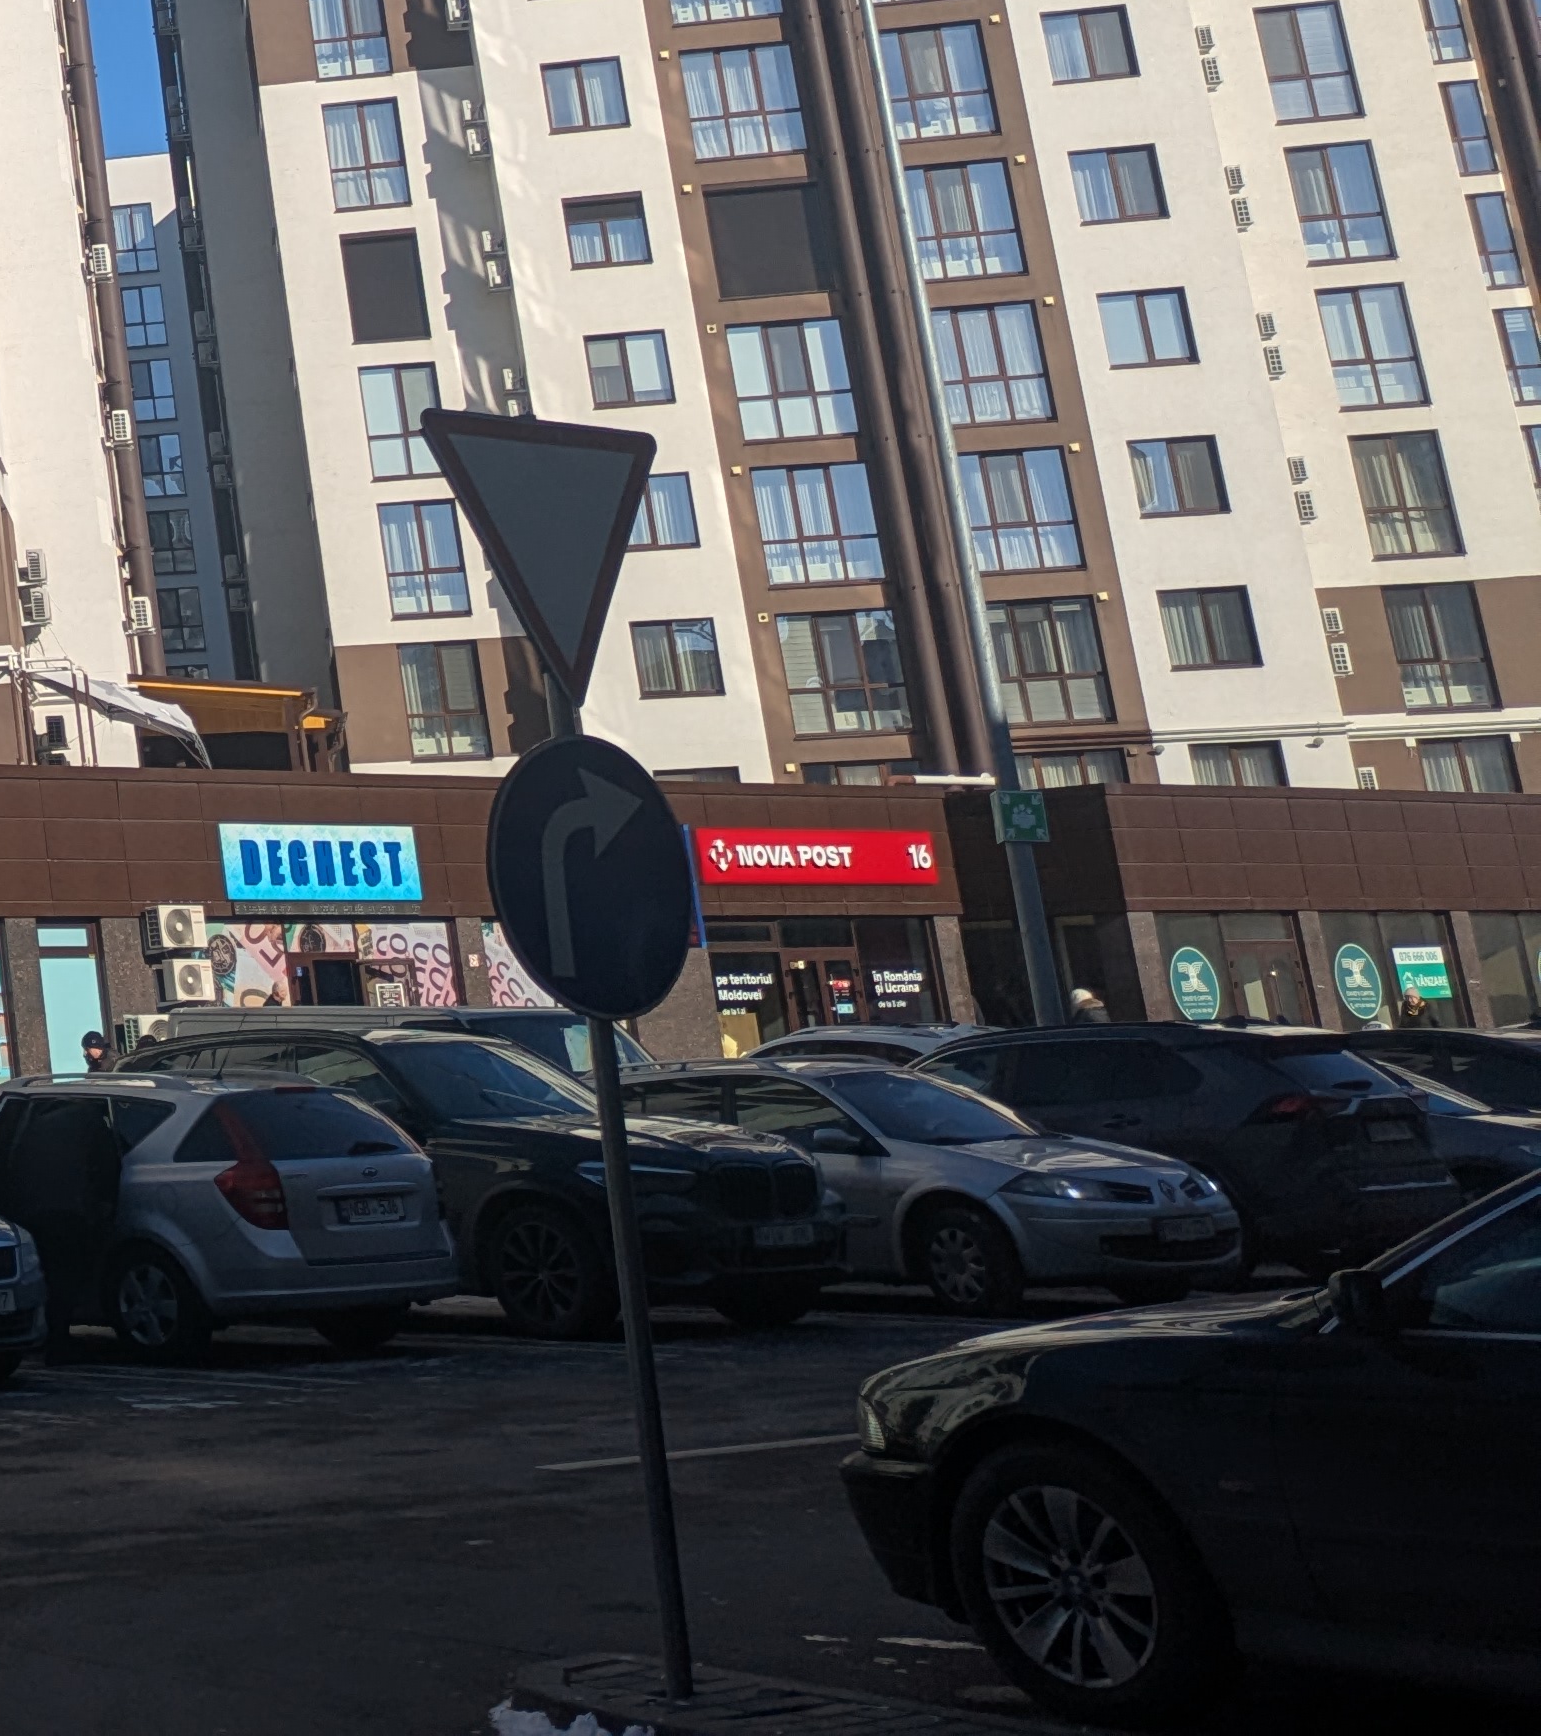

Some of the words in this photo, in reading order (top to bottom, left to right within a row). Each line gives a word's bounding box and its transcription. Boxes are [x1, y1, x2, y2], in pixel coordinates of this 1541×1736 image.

[239, 839, 403, 888] DEGHEST
[735, 844, 796, 868] NOVA
[796, 844, 853, 868] POST
[907, 843, 932, 870] 16
[715, 975, 728, 987] pe
[729, 972, 773, 985] teritoriul
[717, 988, 763, 1001] Moldovei
